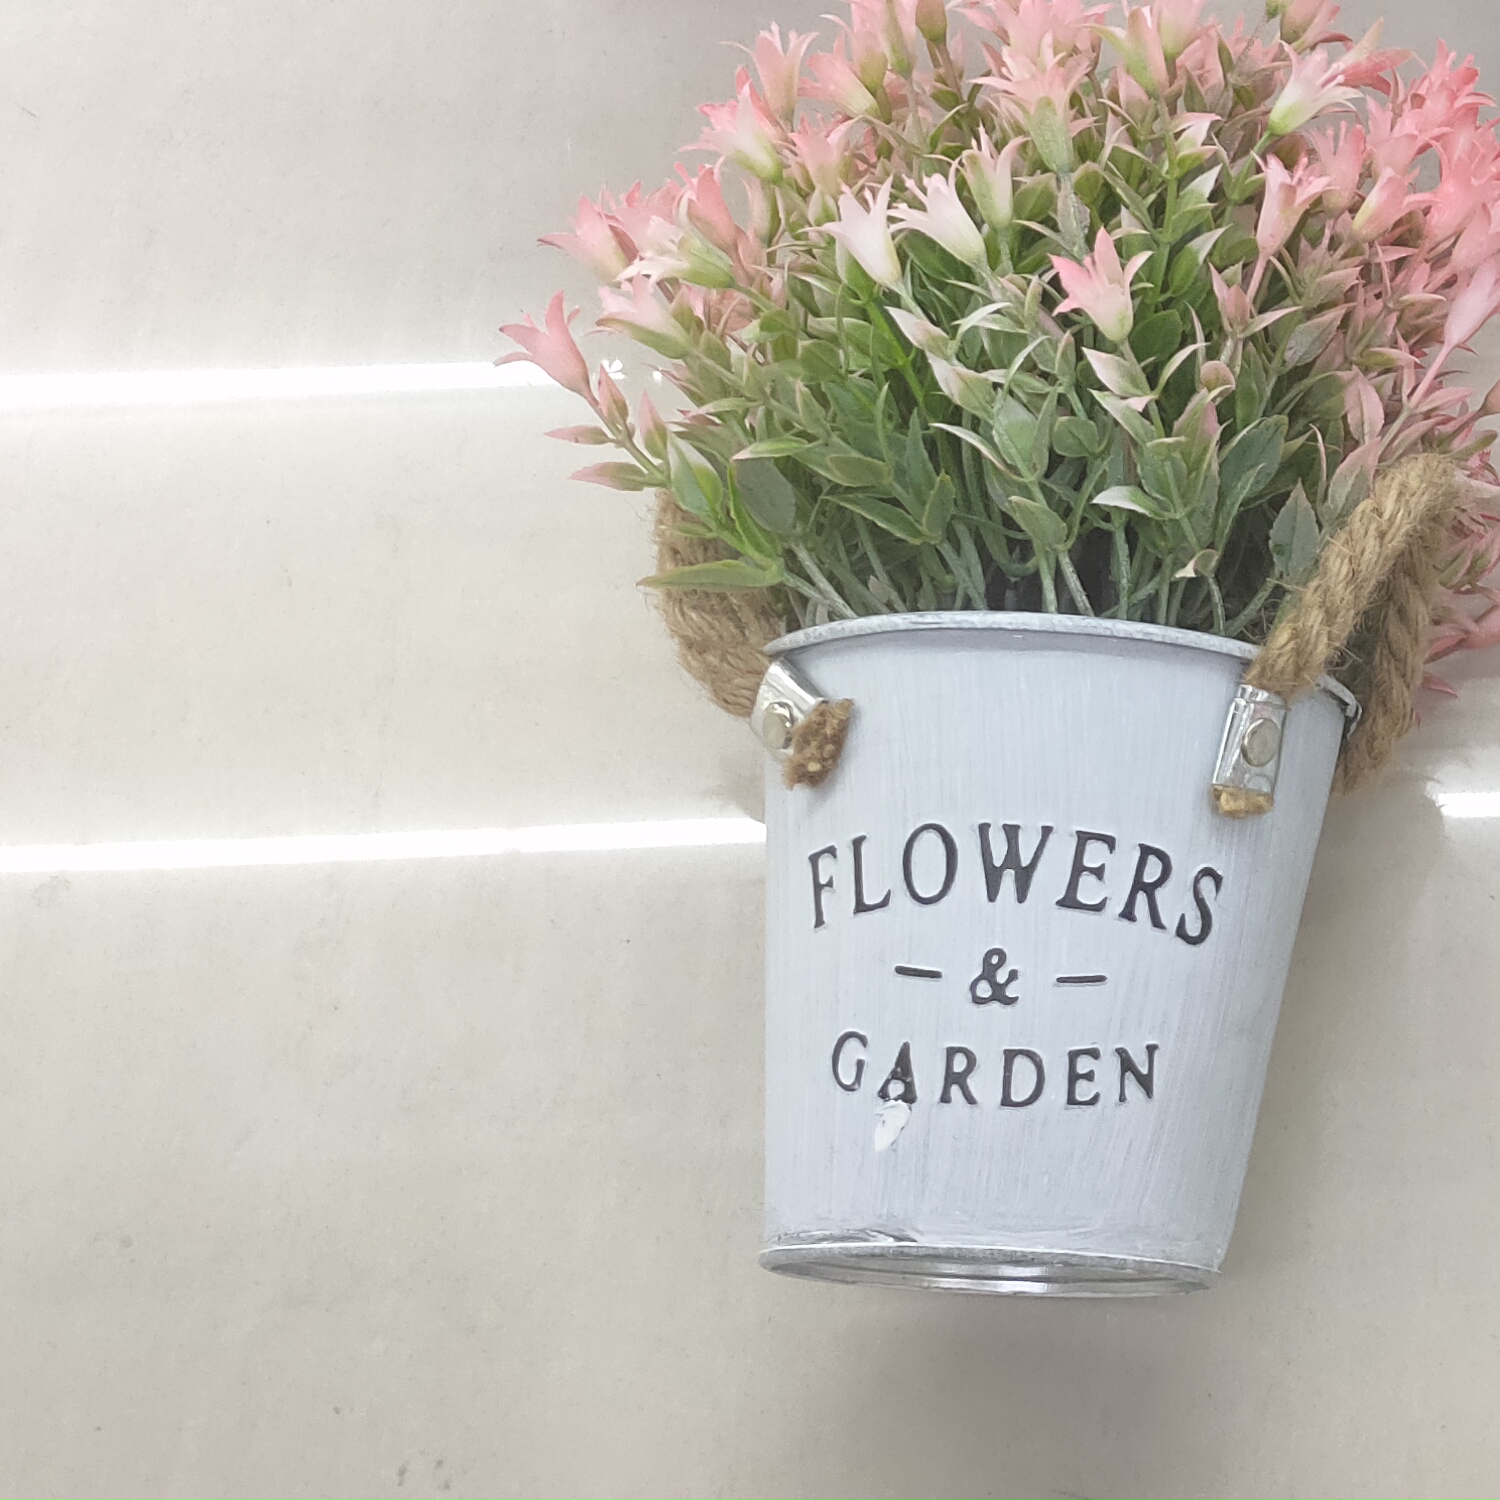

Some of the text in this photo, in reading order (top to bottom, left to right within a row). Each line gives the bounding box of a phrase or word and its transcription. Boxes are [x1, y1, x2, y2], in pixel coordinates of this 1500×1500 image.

[807, 822, 1224, 946] FLOWERS
[969, 947, 1020, 1005] &
[831, 1029, 1160, 1107] GARDEN
